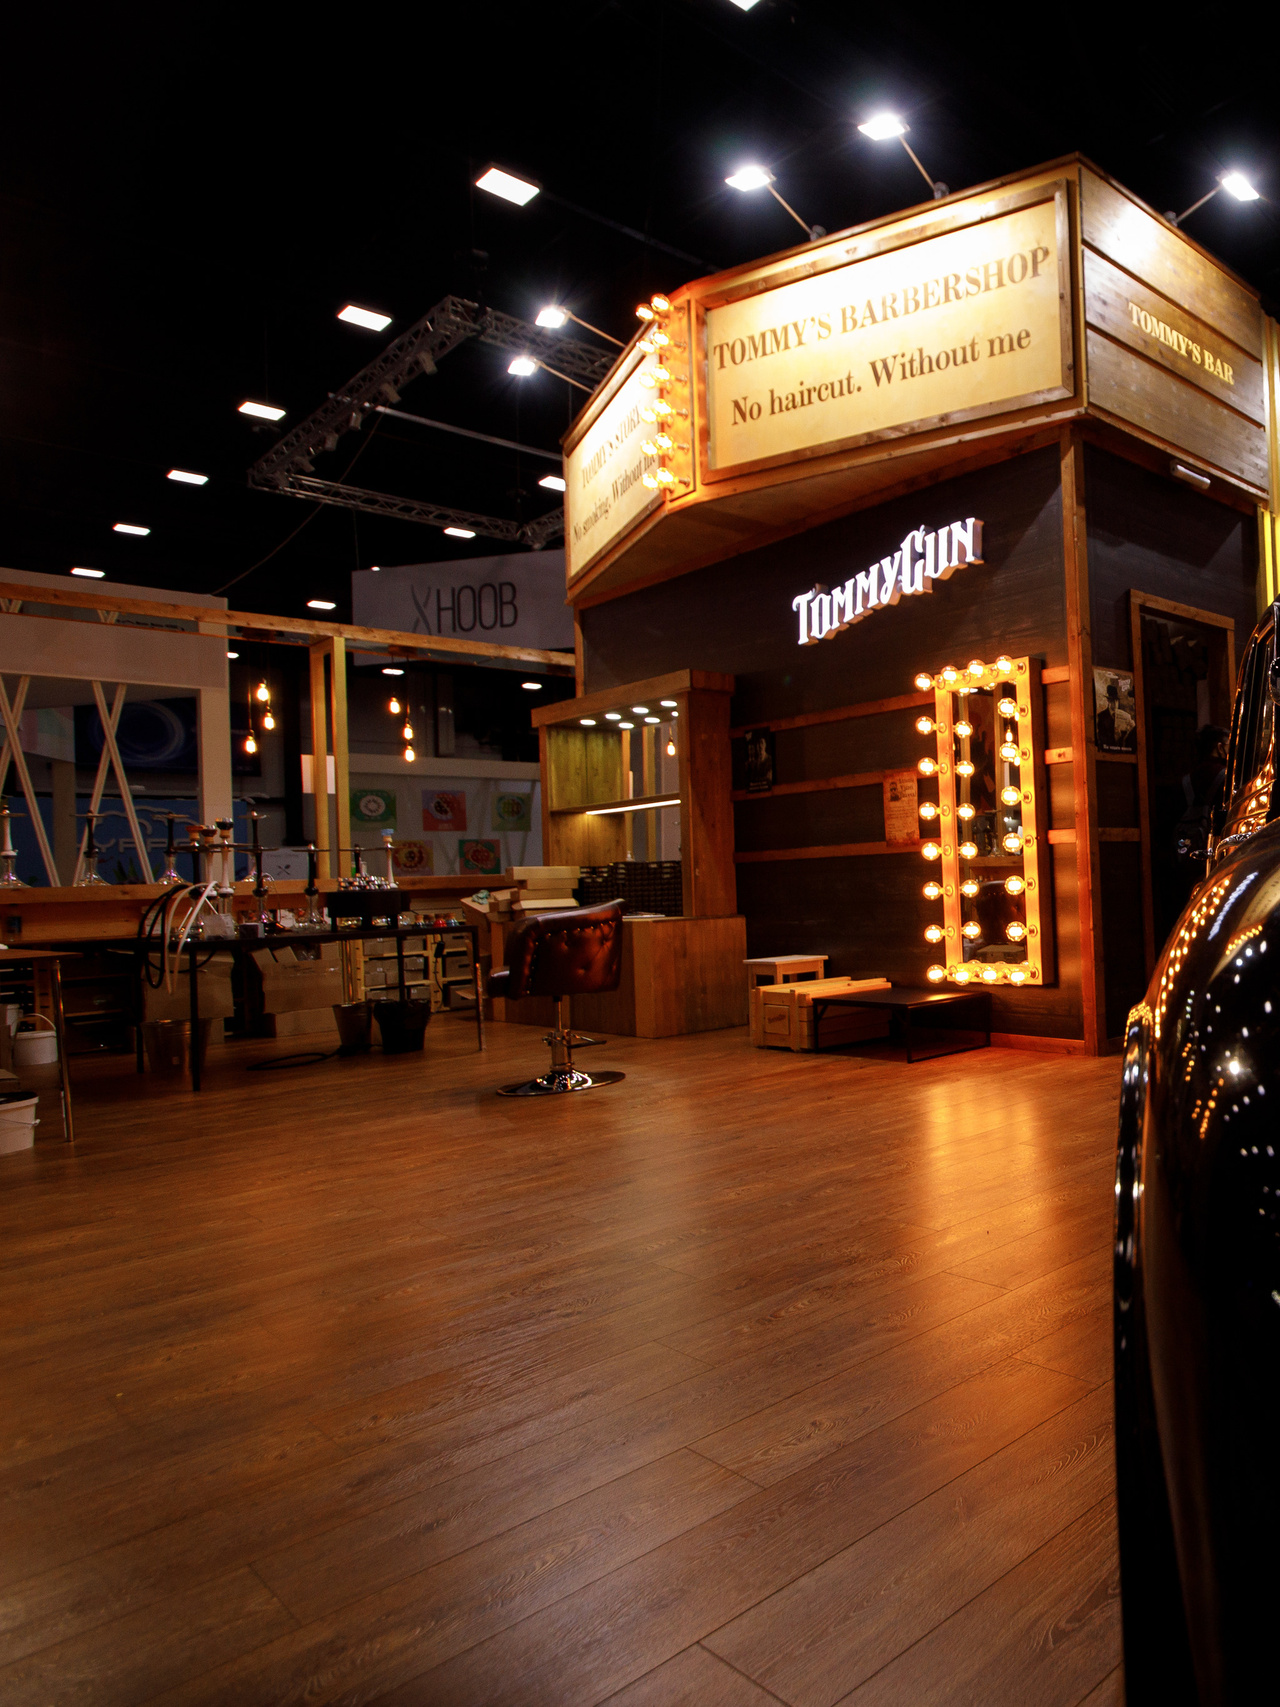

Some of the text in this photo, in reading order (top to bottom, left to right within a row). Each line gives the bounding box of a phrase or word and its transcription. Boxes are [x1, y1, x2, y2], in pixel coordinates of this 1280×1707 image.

[713, 246, 1050, 369] TOMMY'S BARBERSHOP
[1129, 302, 1234, 385] TOMMY'S BAR
[731, 328, 1031, 426] No haircut. Without me
[611, 459, 643, 503] Without
